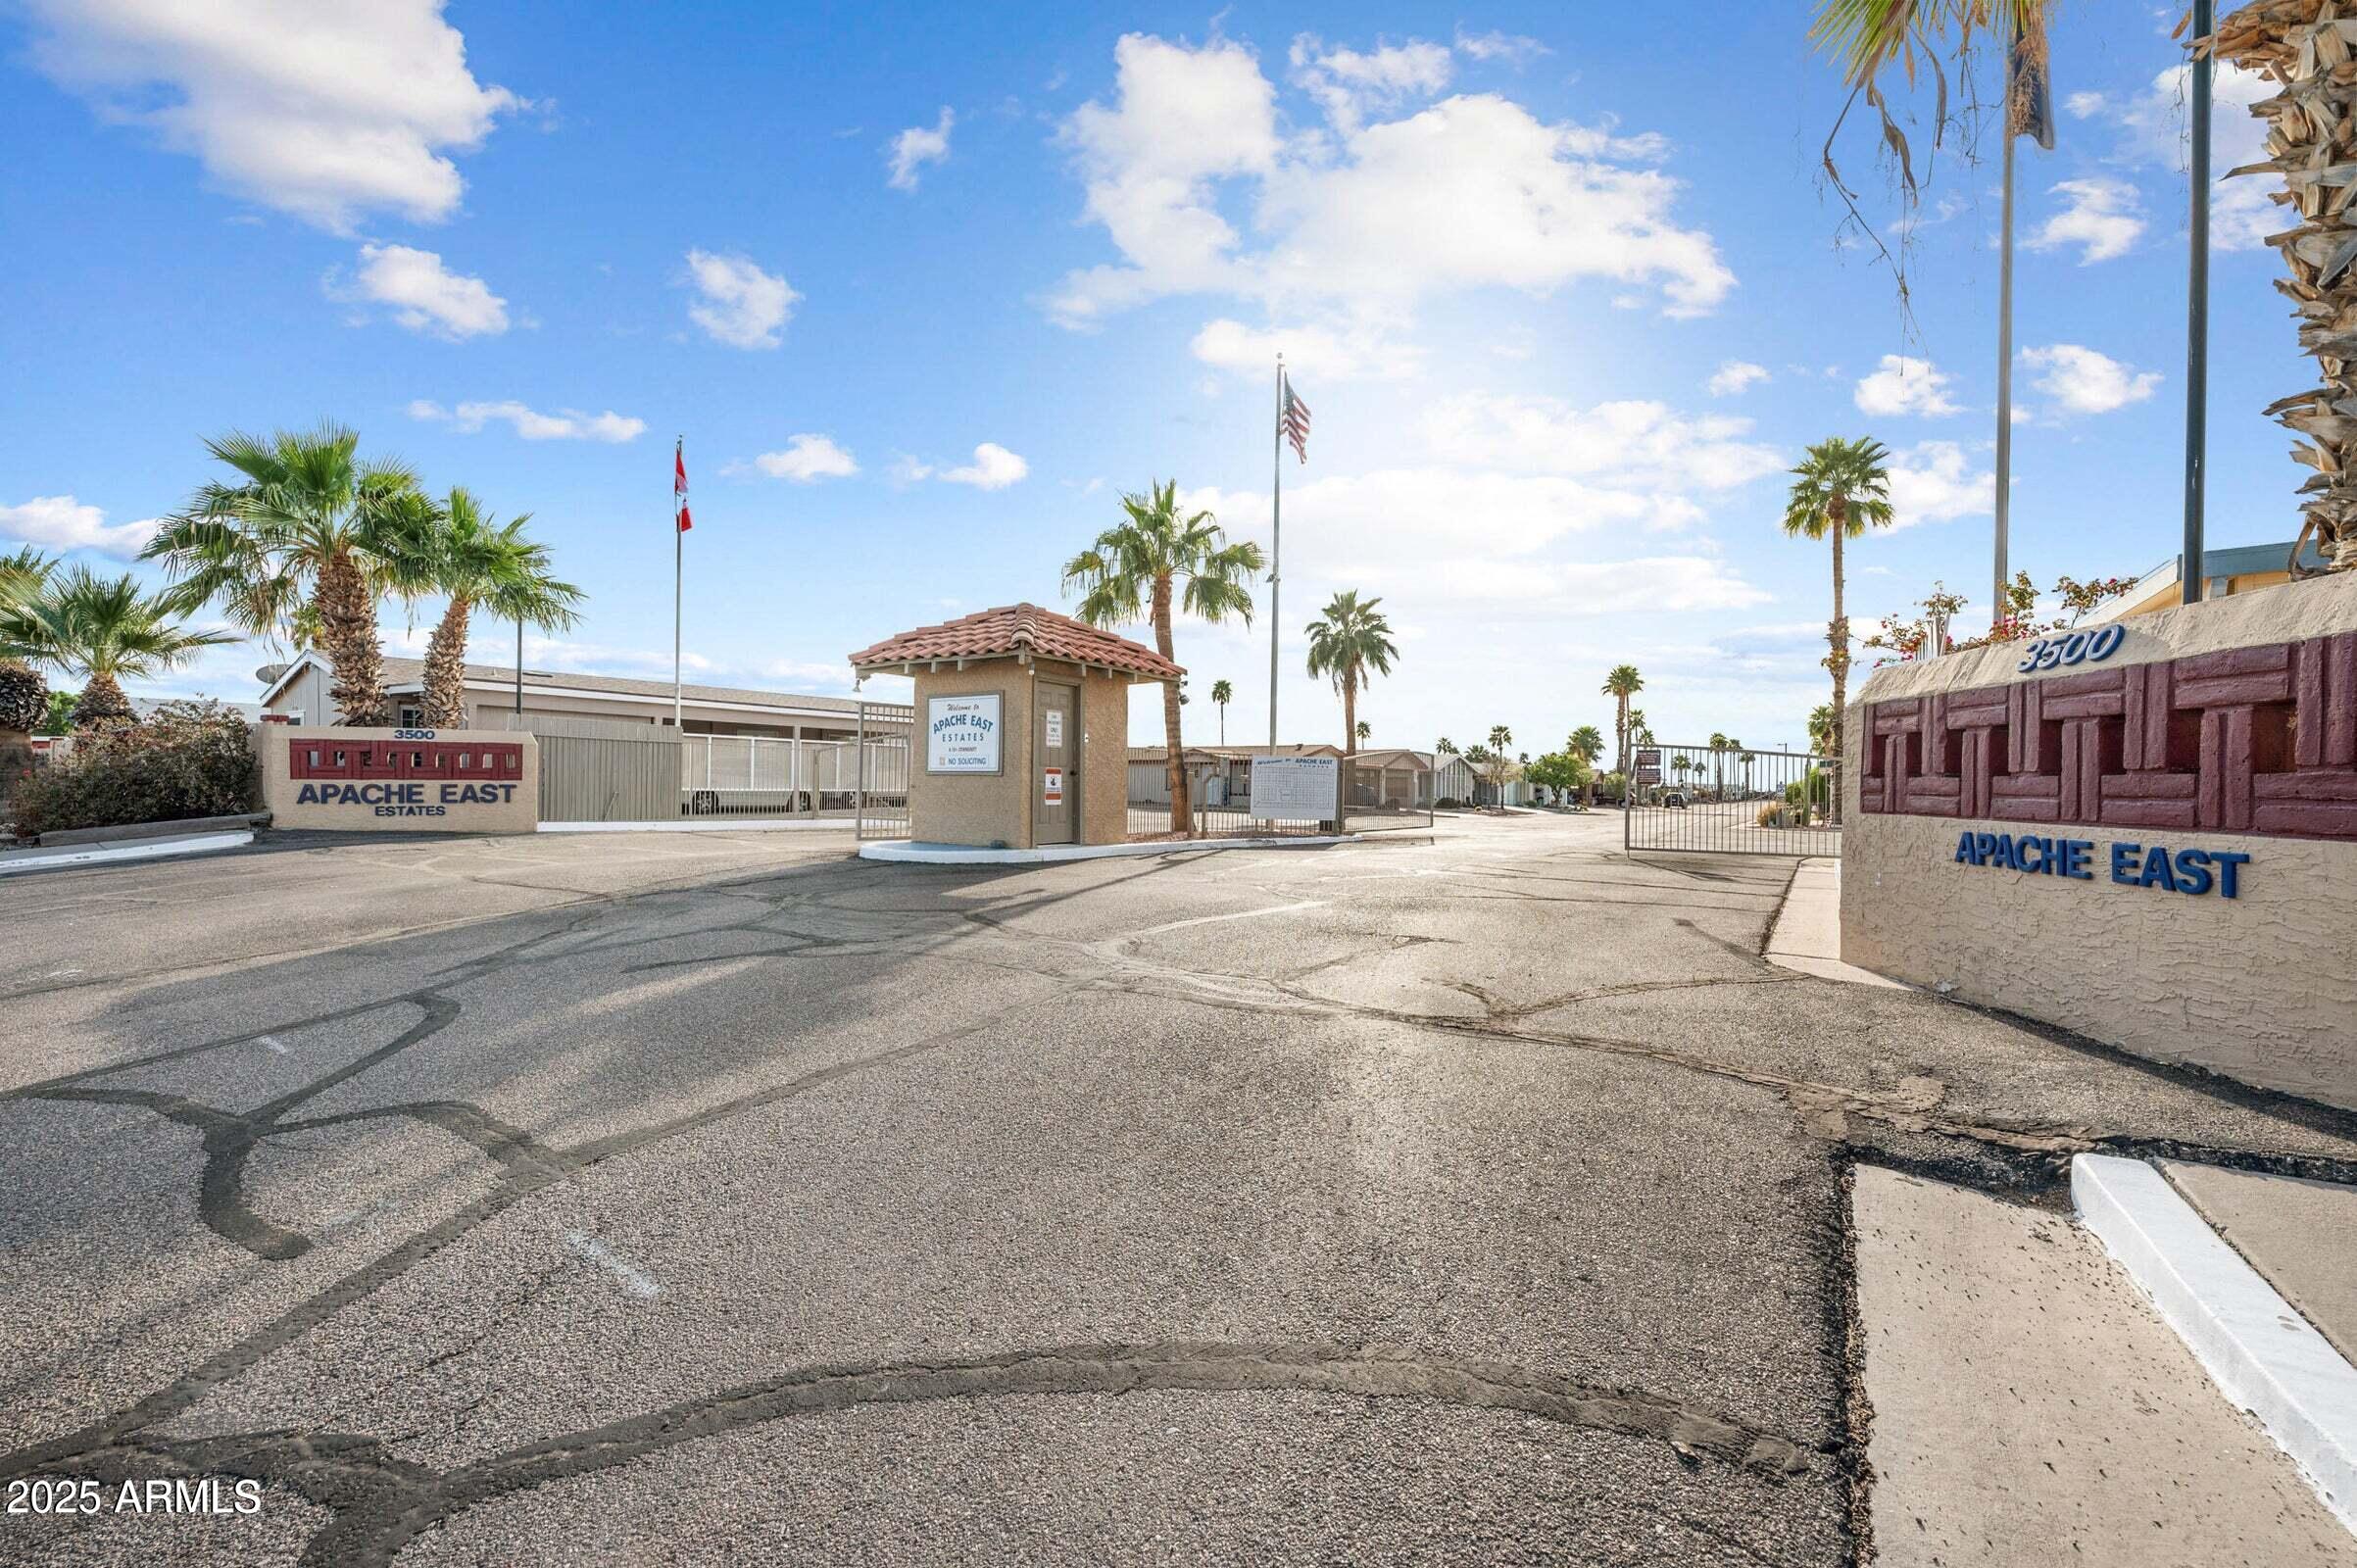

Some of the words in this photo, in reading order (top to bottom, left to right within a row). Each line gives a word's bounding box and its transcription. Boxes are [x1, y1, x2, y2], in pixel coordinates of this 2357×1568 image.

[2017, 624, 2126, 673] 3500
[933, 713, 967, 734] APACHE
[970, 714, 994, 732] EAST
[394, 729, 435, 740] 3500
[942, 732, 984, 742] ESTATES
[296, 783, 424, 805] APACHE
[440, 783, 516, 804] EAST
[374, 805, 446, 816] ESTATES
[1954, 831, 2094, 880] APACHE
[2111, 842, 2250, 899] EAST
